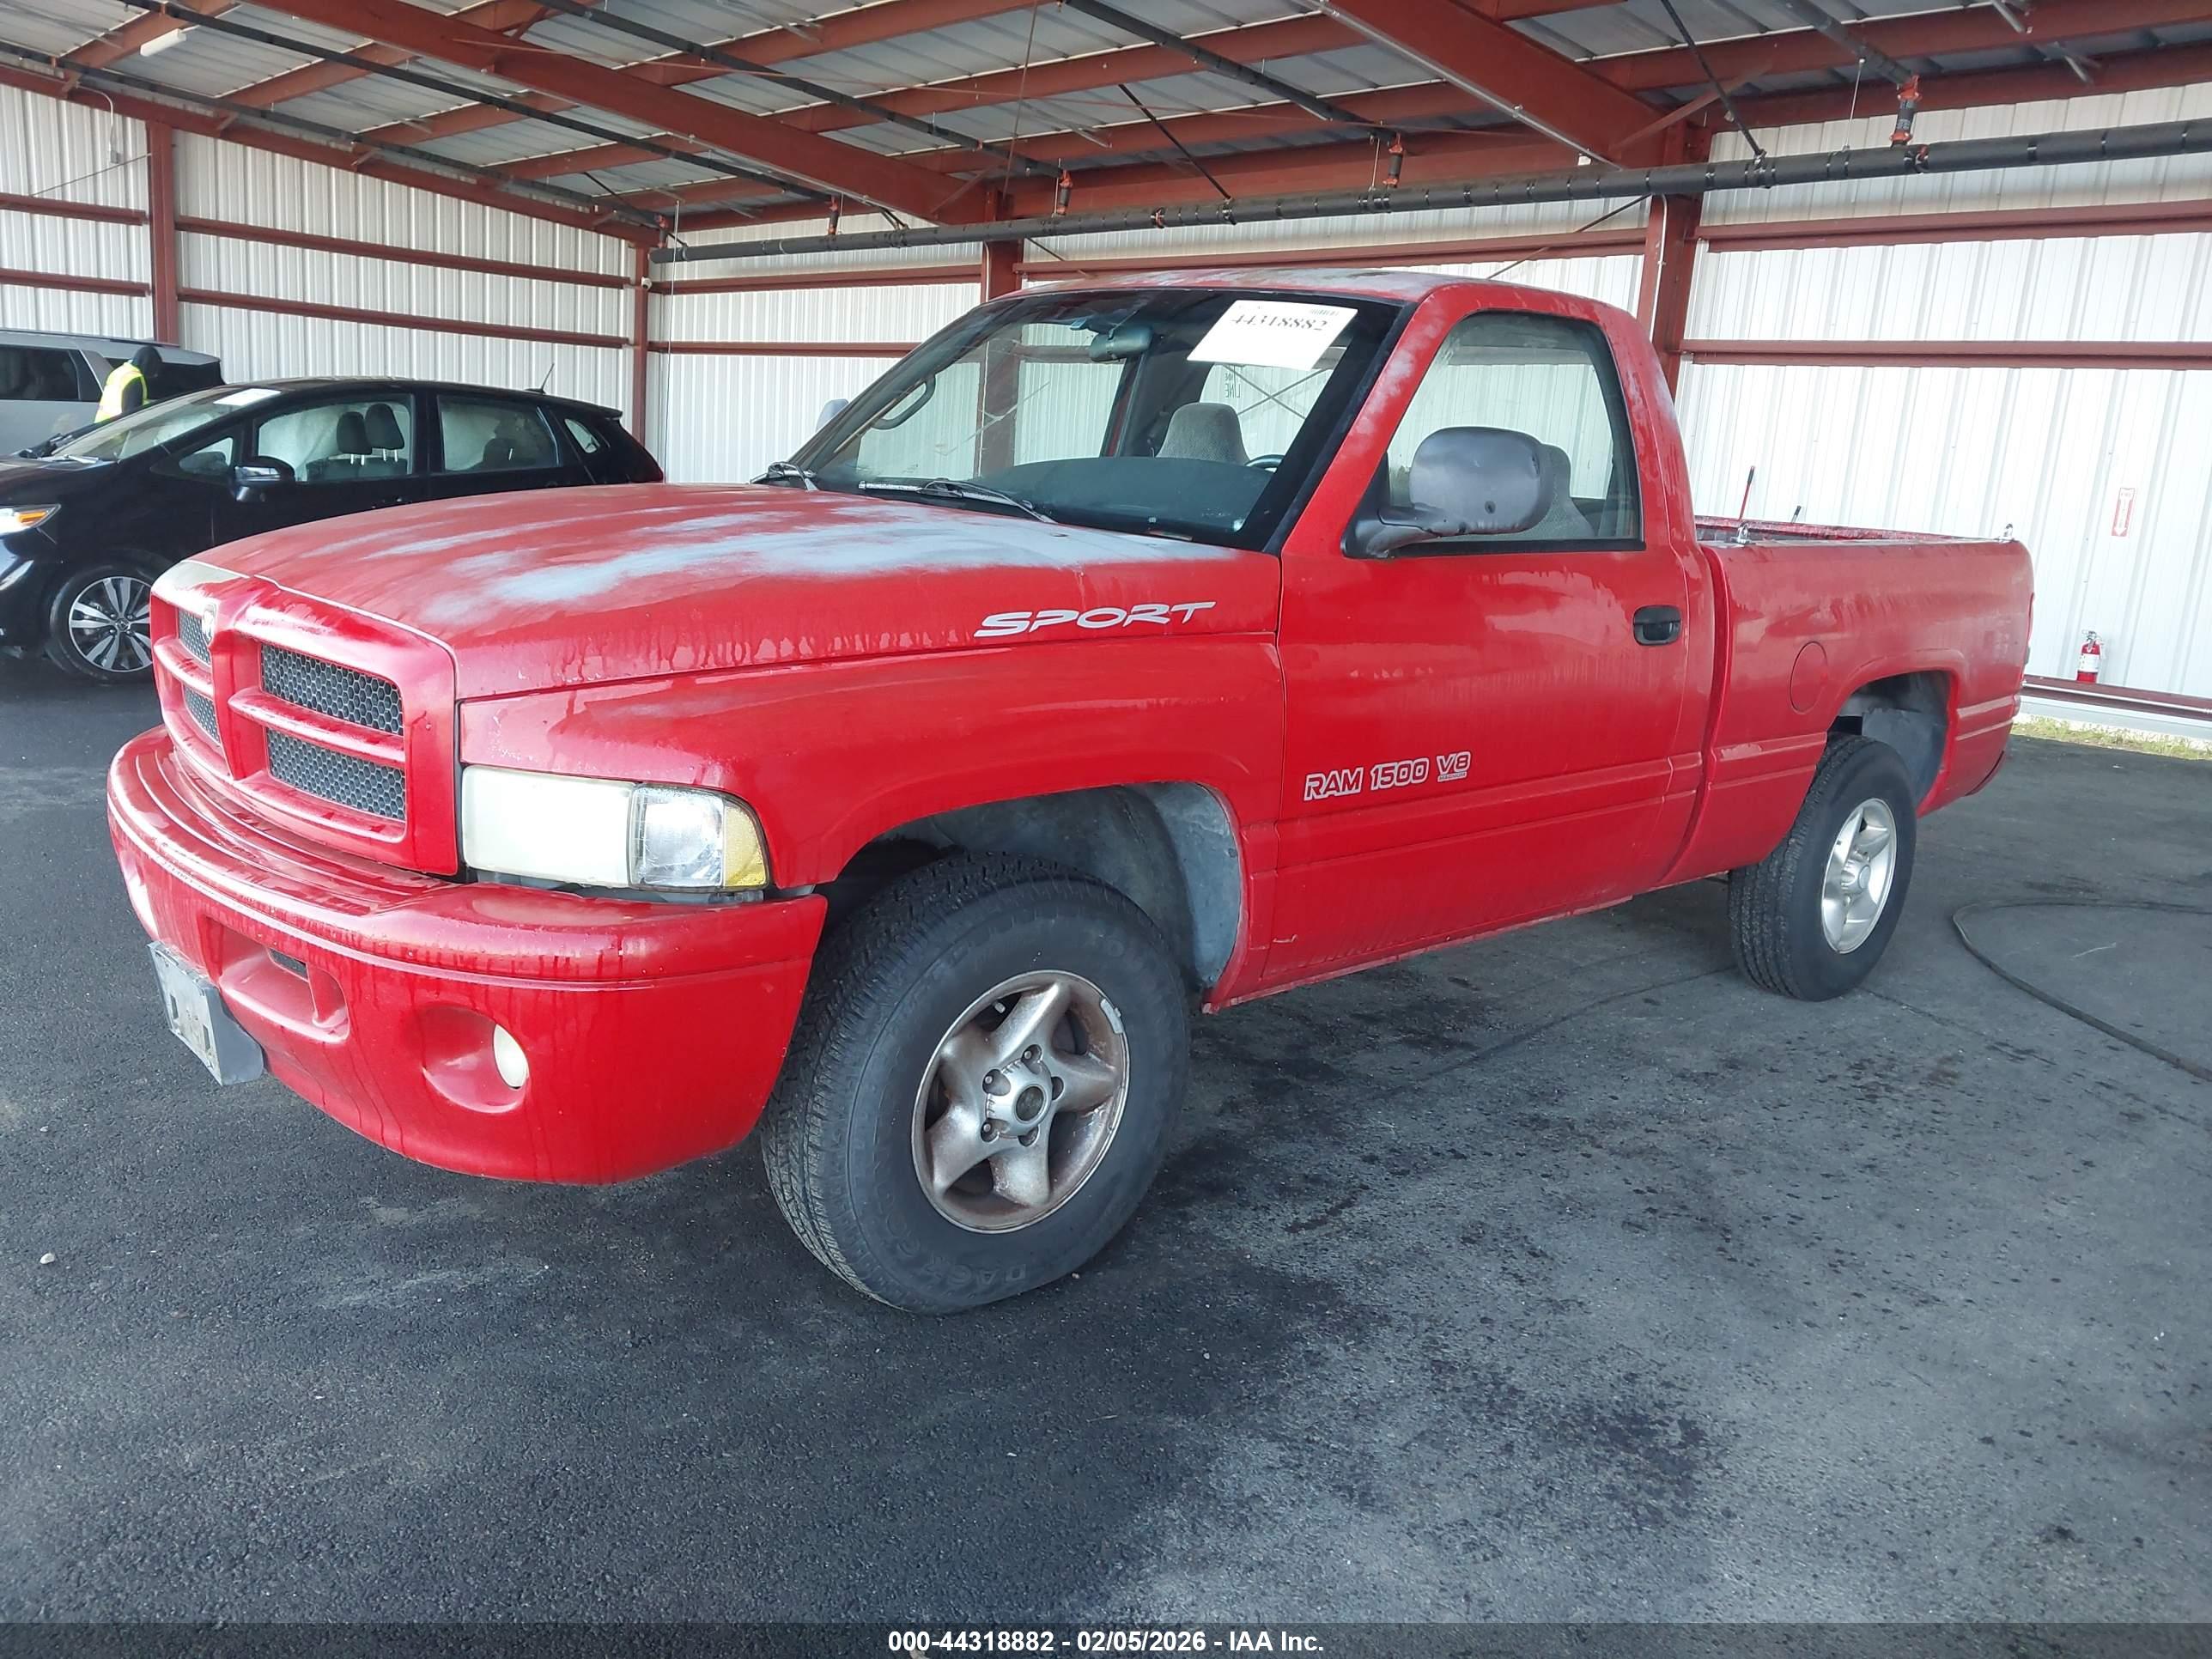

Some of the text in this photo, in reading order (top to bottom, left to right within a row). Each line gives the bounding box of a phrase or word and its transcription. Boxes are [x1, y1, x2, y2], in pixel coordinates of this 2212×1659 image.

[1231, 314, 1328, 331] 44318882
[973, 601, 1217, 637] SPORT
[1304, 750, 1471, 801] RAM 1500 V8
